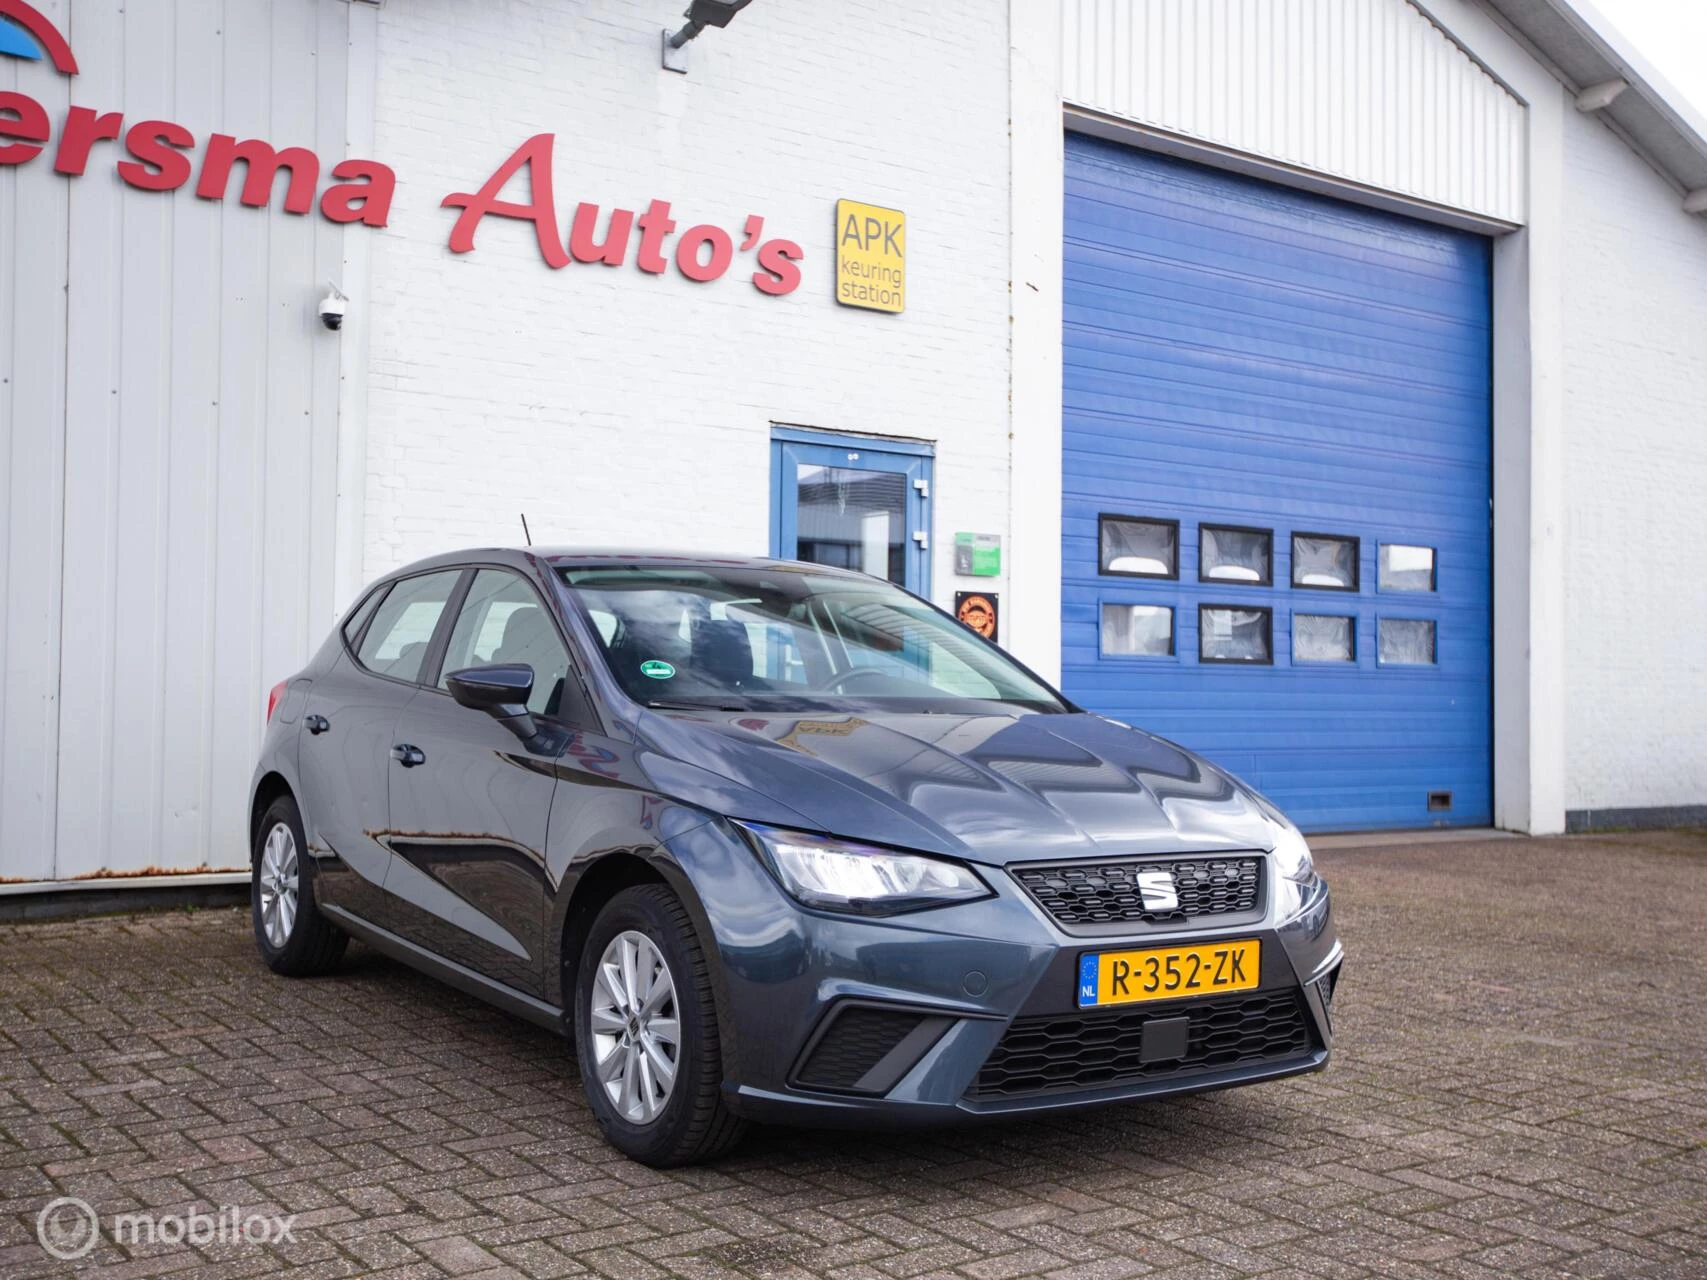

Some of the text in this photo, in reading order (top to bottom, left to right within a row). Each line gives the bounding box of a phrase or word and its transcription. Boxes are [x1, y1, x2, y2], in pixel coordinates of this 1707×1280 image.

[841, 213, 903, 258] APK
[841, 255, 902, 289] keuring
[842, 281, 902, 306] station
[1112, 949, 1246, 996] R-352-ZK
[1082, 986, 1095, 997] NL
